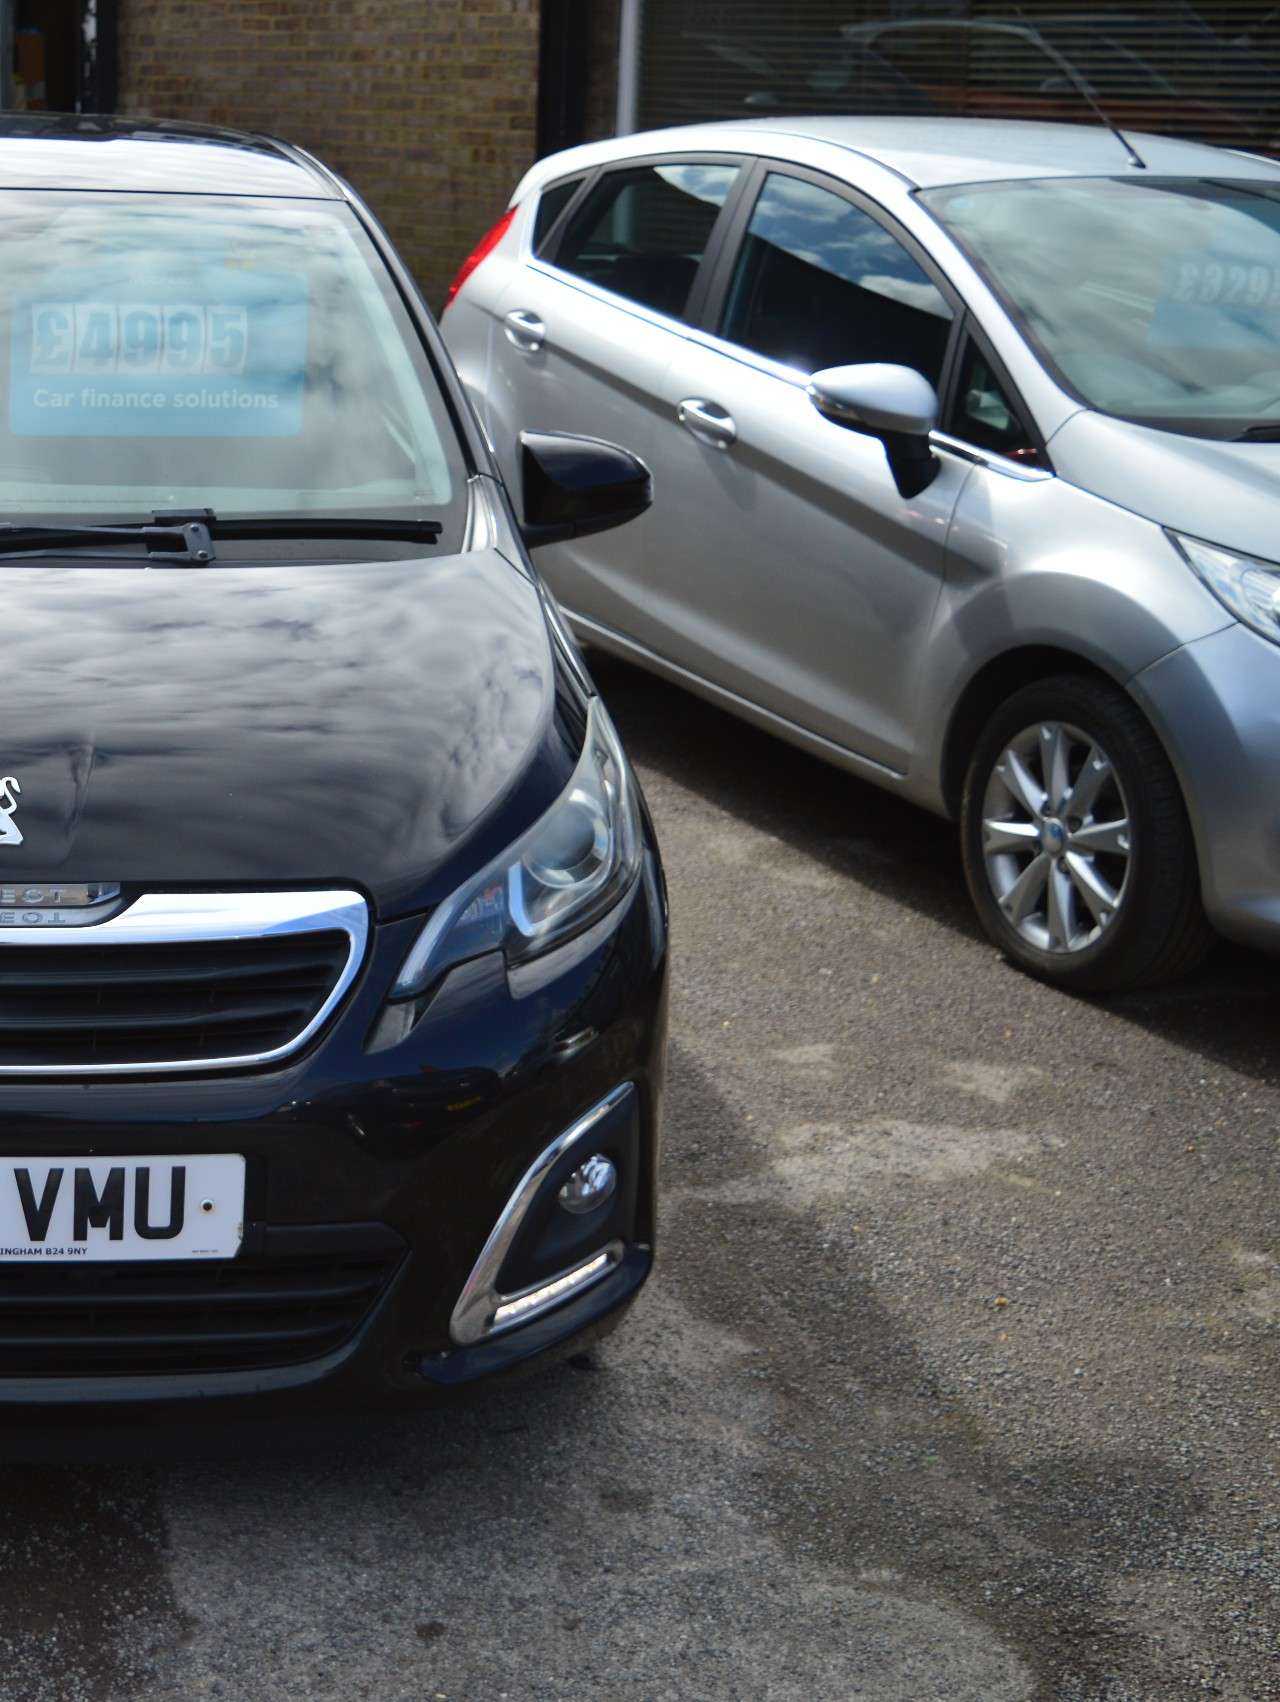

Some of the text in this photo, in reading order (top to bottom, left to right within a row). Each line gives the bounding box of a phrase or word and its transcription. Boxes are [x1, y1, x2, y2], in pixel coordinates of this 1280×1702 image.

[33, 310, 245, 369] £4995
[33, 387, 280, 409] Car finance solutions
[13, 1165, 186, 1242] VMU
[45, 1247, 65, 1256] B24
[66, 1247, 88, 1256] 9NY
